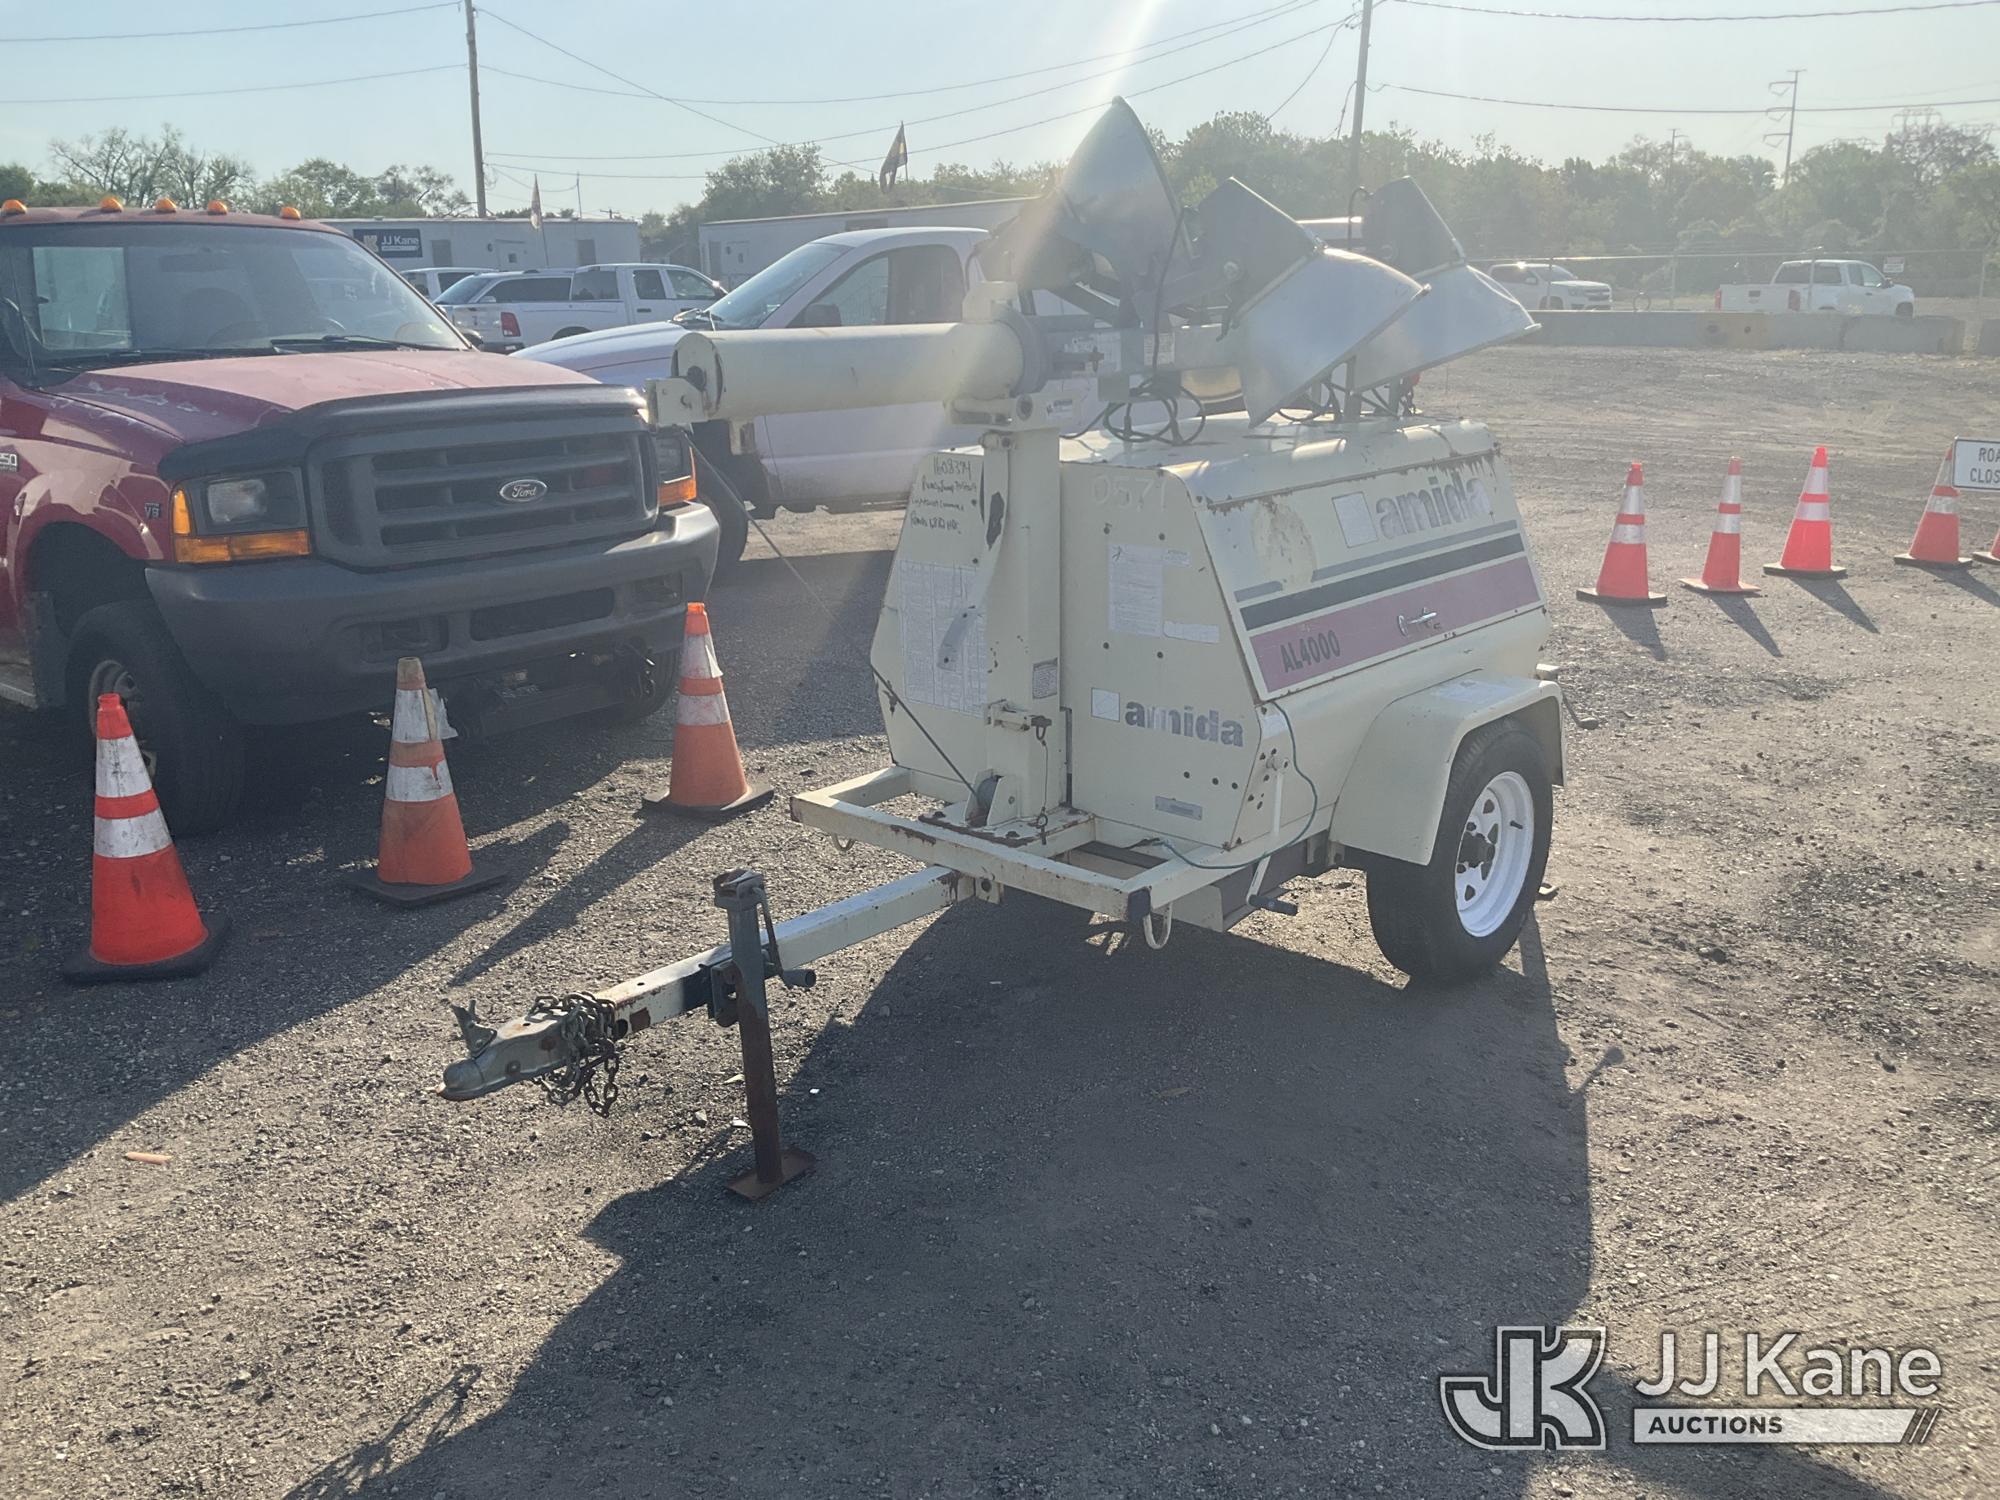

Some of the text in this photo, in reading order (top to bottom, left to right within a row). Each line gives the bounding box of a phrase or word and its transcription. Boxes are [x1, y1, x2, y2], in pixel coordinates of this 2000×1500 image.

[511, 484, 537, 498] Ford
[1375, 471, 1490, 540] amida
[1280, 630, 1341, 673] AL4000
[1125, 701, 1243, 747] amida
